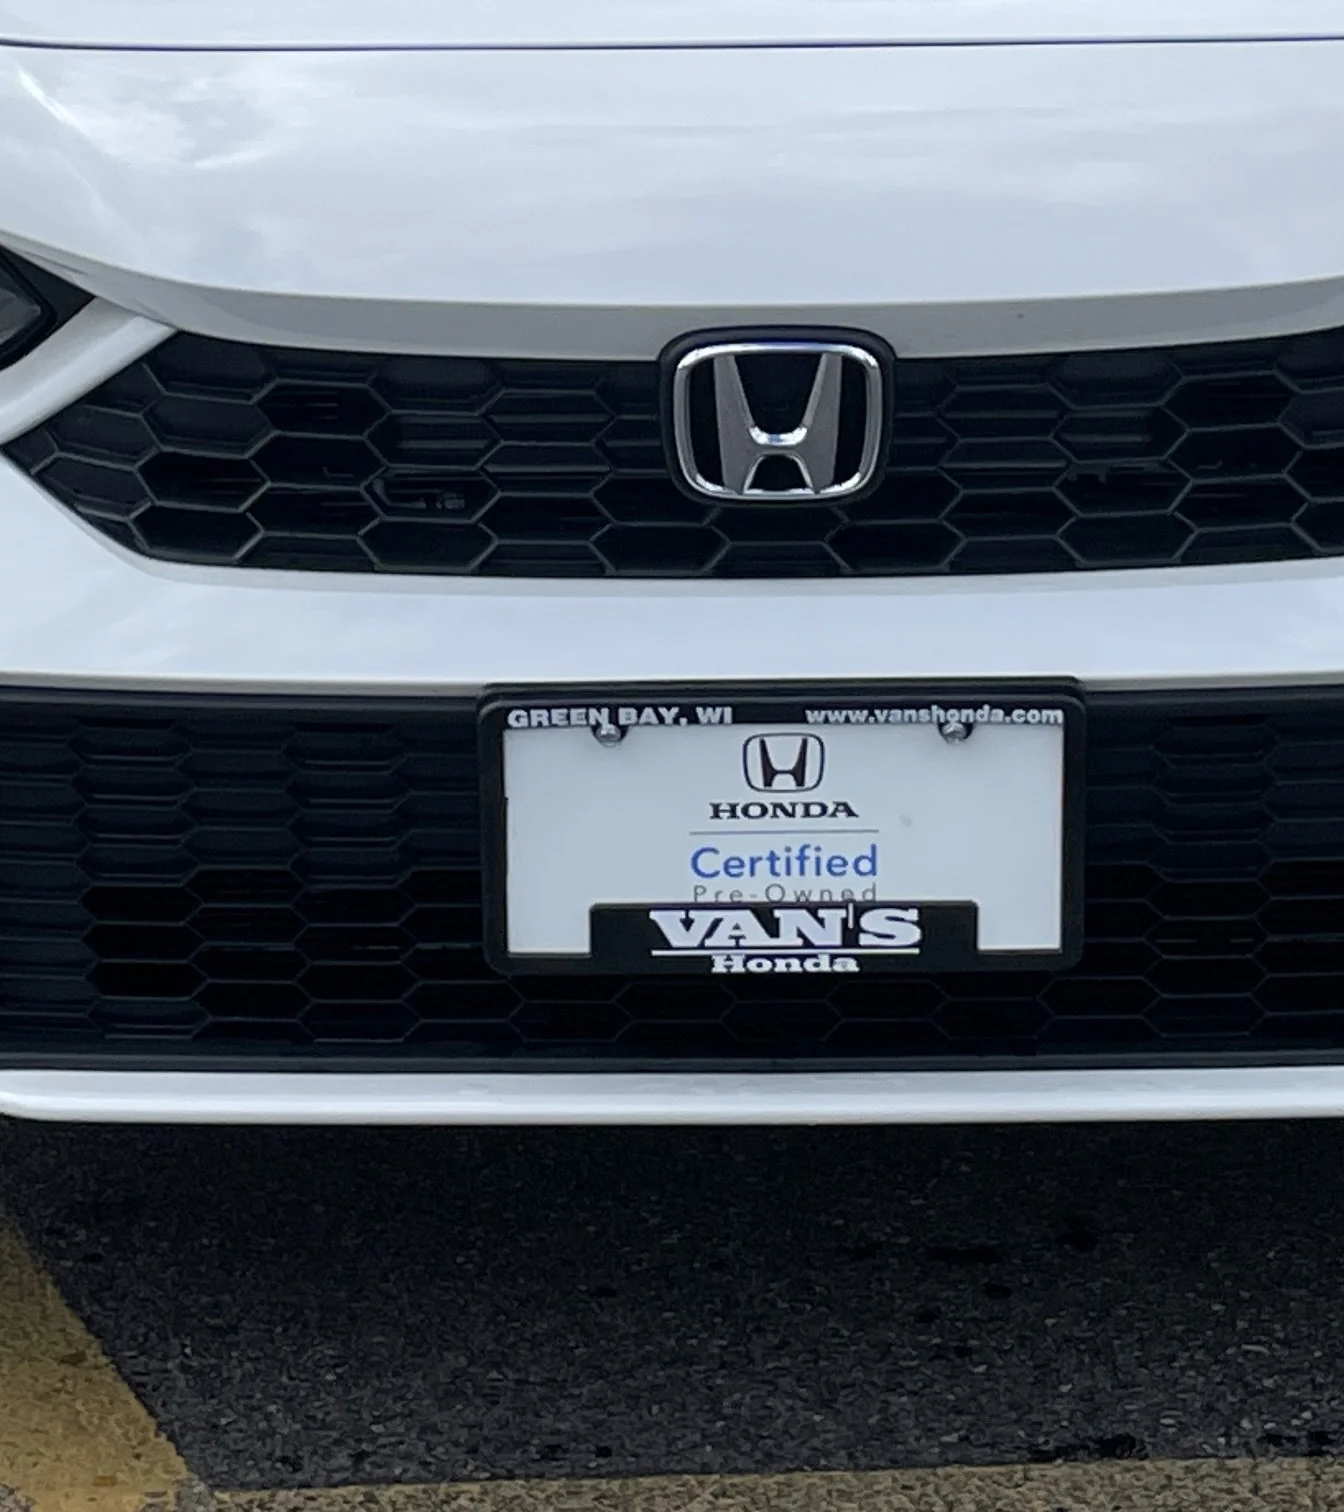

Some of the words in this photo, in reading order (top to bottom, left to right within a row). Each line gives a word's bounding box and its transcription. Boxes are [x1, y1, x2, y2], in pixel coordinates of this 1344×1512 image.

[507, 707, 609, 728] GREEN
[696, 706, 733, 725] WI
[806, 704, 1064, 725] www.vanshonda.com
[709, 801, 859, 820] HONDA
[690, 843, 878, 879] Certified
[693, 882, 878, 903] Pre-Owned
[649, 902, 923, 948] VAN'S
[711, 953, 860, 974] Honda
